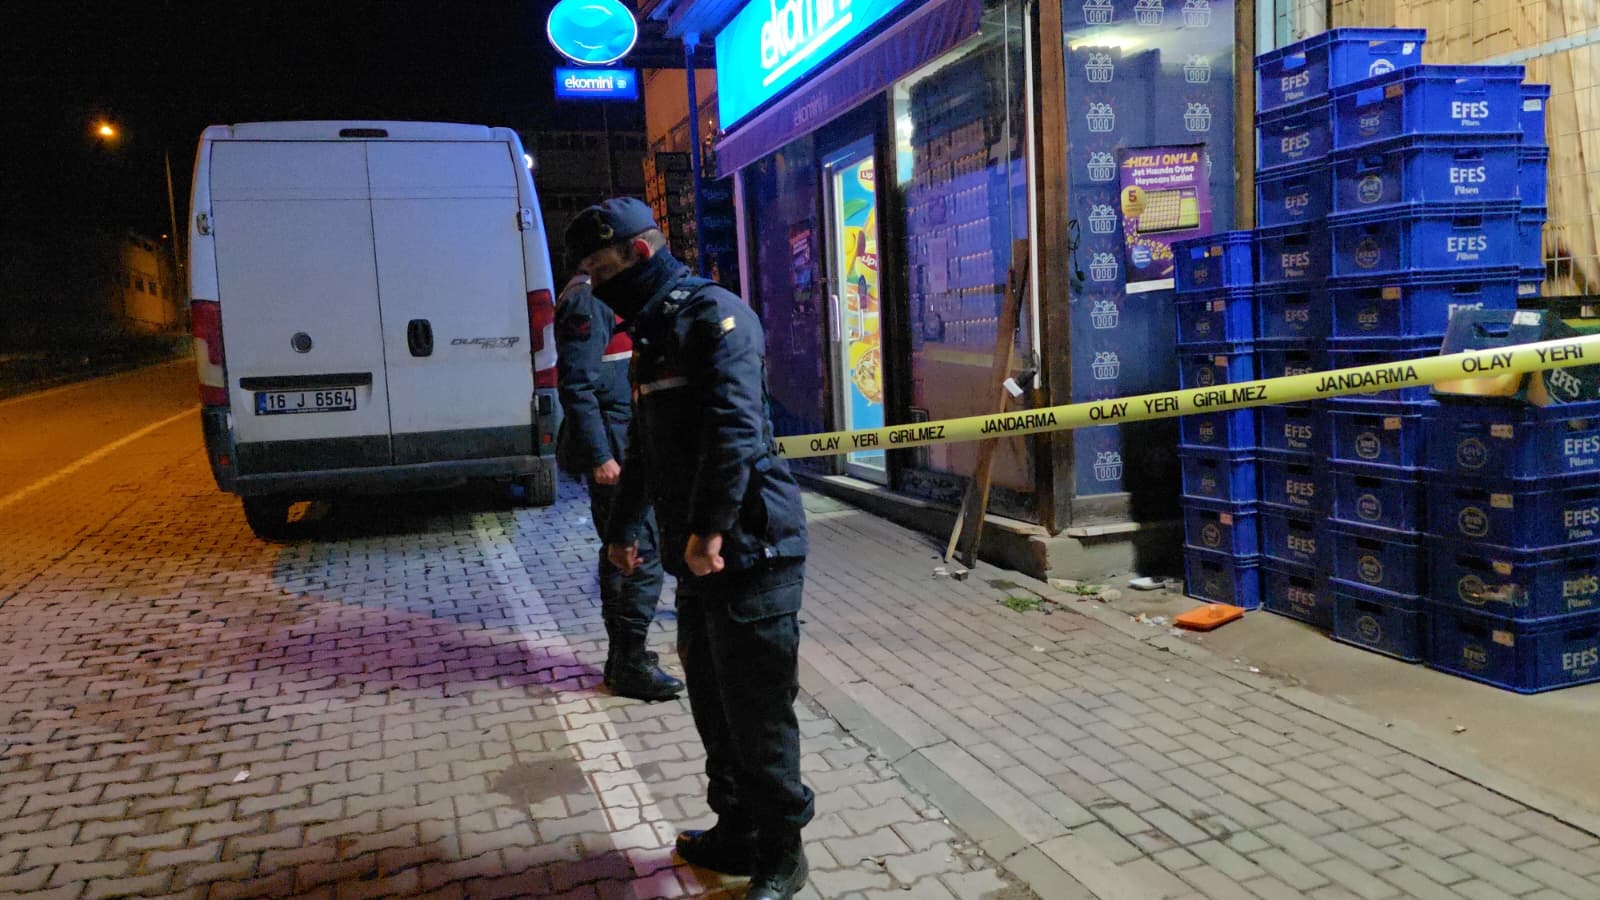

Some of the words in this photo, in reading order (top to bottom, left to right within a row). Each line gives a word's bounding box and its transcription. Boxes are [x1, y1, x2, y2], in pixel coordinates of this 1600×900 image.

[565, 75, 613, 89] ekomini
[1282, 70, 1309, 91] EFES
[1451, 100, 1489, 119] EFES
[1281, 132, 1310, 153] EFES
[862, 171, 874, 179] Lip
[1450, 166, 1486, 184] EFES
[1128, 190, 1137, 202] 5
[1285, 192, 1309, 209] EFES
[1447, 235, 1488, 252] EFES
[862, 255, 877, 267] Lip
[1282, 251, 1310, 268] EFES
[1285, 310, 1309, 322] EFES
[1550, 367, 1582, 398] EFES
[269, 394, 286, 408] 16
[297, 393, 305, 407] J
[315, 391, 352, 406] 6564
[810, 436, 840, 453] OLAY
[981, 412, 1057, 434] JANDARMA
[1089, 402, 1128, 421] OLAY
[1315, 366, 1418, 393] JANDARMA
[1462, 352, 1513, 373] OLAY
[1284, 424, 1313, 439] EFES
[1564, 435, 1600, 456] EFES
[1286, 480, 1315, 497] EFES
[1563, 507, 1600, 528] EFES
[1287, 535, 1316, 554] EFES
[1562, 576, 1599, 598] EFES
[1288, 588, 1316, 607] EFES
[1562, 648, 1599, 671] EFES
